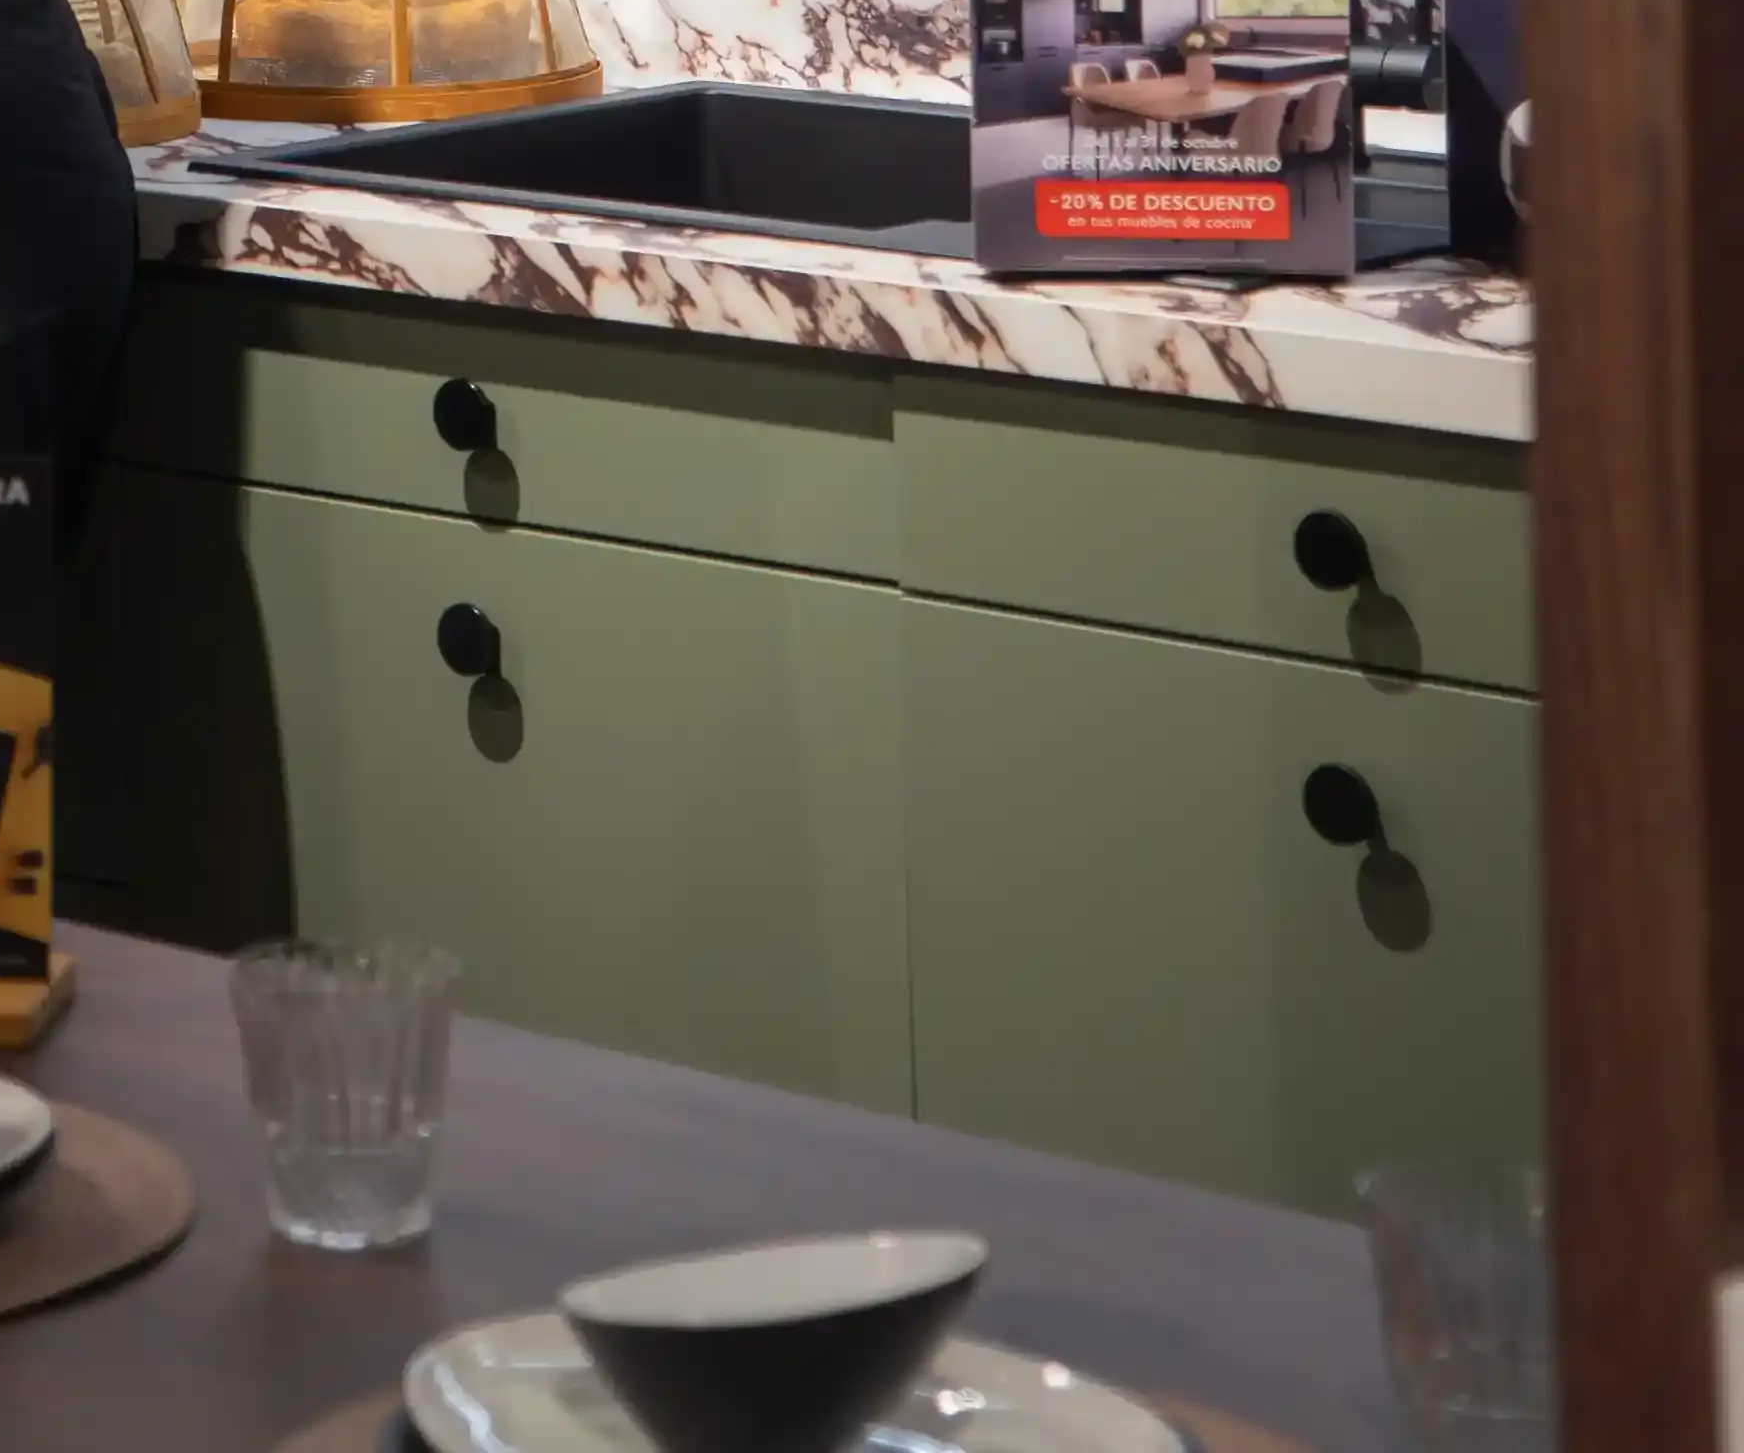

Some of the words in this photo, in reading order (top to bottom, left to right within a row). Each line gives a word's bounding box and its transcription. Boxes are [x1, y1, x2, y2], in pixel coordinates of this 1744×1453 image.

[1042, 155, 1134, 172] OFERTAS
[1139, 156, 1282, 173] ANIVERSARIO
[1109, 194, 1137, 211] DE
[1143, 194, 1276, 211] DESCUENTO
[1067, 217, 1086, 227] en
[1090, 216, 1113, 227] tus
[1117, 215, 1177, 229] muebles
[1182, 215, 1200, 229] de
